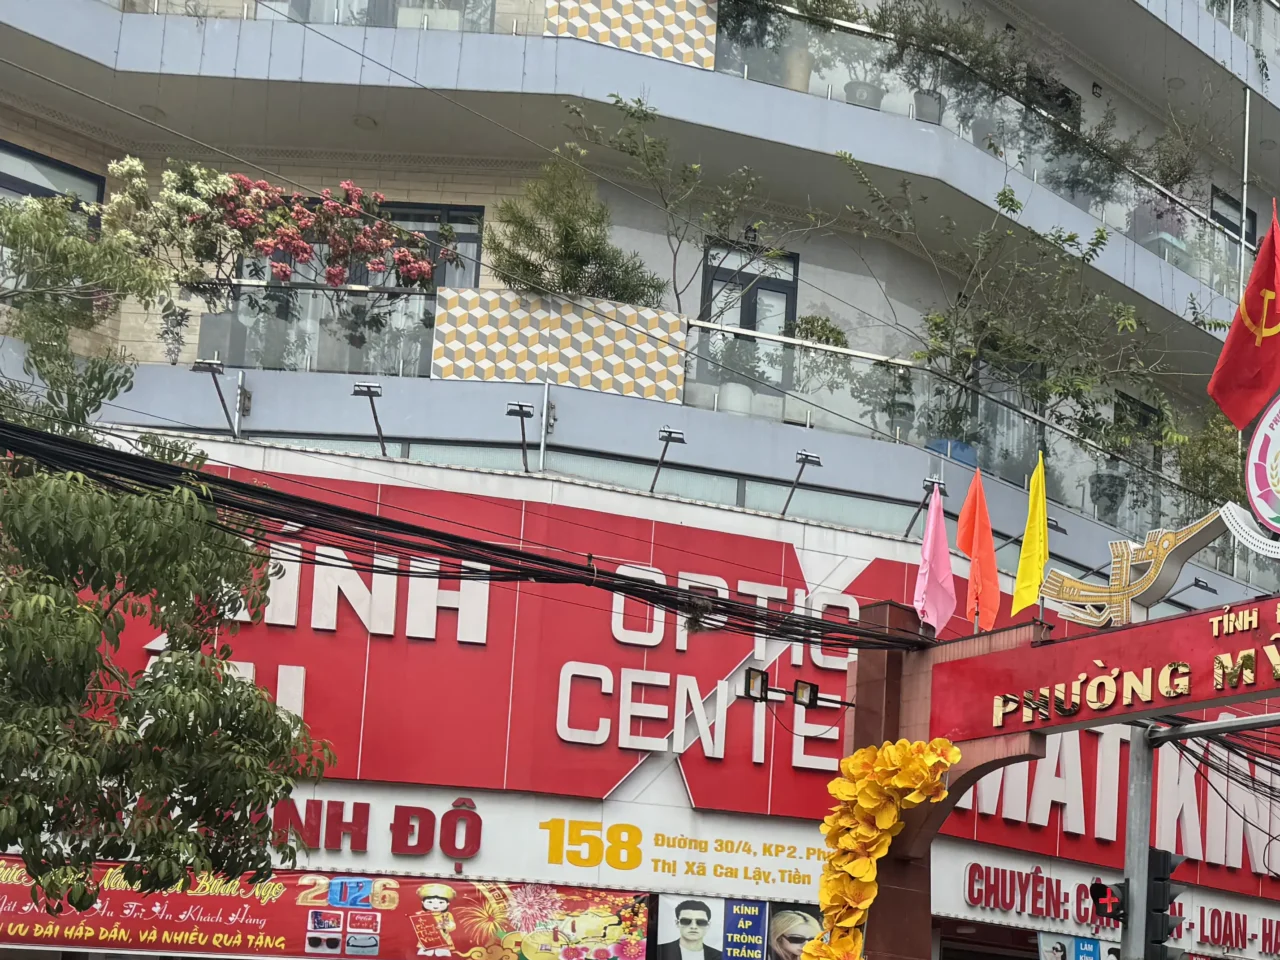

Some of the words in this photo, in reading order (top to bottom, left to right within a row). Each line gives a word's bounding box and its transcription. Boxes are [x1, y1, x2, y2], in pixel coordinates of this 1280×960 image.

[611, 564, 860, 671] OPTIC
[1209, 605, 1259, 637] TỈNH
[992, 659, 1191, 728] PHƯỜNG
[390, 796, 483, 874] ĐỘ
[538, 817, 643, 870] 158
[653, 832, 709, 853] Đường
[651, 858, 677, 877] Thị
[684, 861, 706, 877] Xã
[713, 863, 739, 879] Cai
[778, 868, 812, 885] Tiền
[295, 874, 400, 910] 2026
[174, 904, 223, 923] Khách
[223, 903, 267, 930] Hàng
[732, 903, 759, 916] KÍNH
[737, 916, 752, 929] ÁP
[33, 920, 60, 939] ĐÃI
[64, 918, 95, 941] HẤP
[140, 925, 157, 943] VÀ
[161, 924, 209, 945] NHIỀU
[212, 929, 242, 948] QUÀ
[247, 930, 286, 952] TẶNG
[726, 930, 763, 945] TRÒNG
[726, 945, 762, 959] TRẮNG
